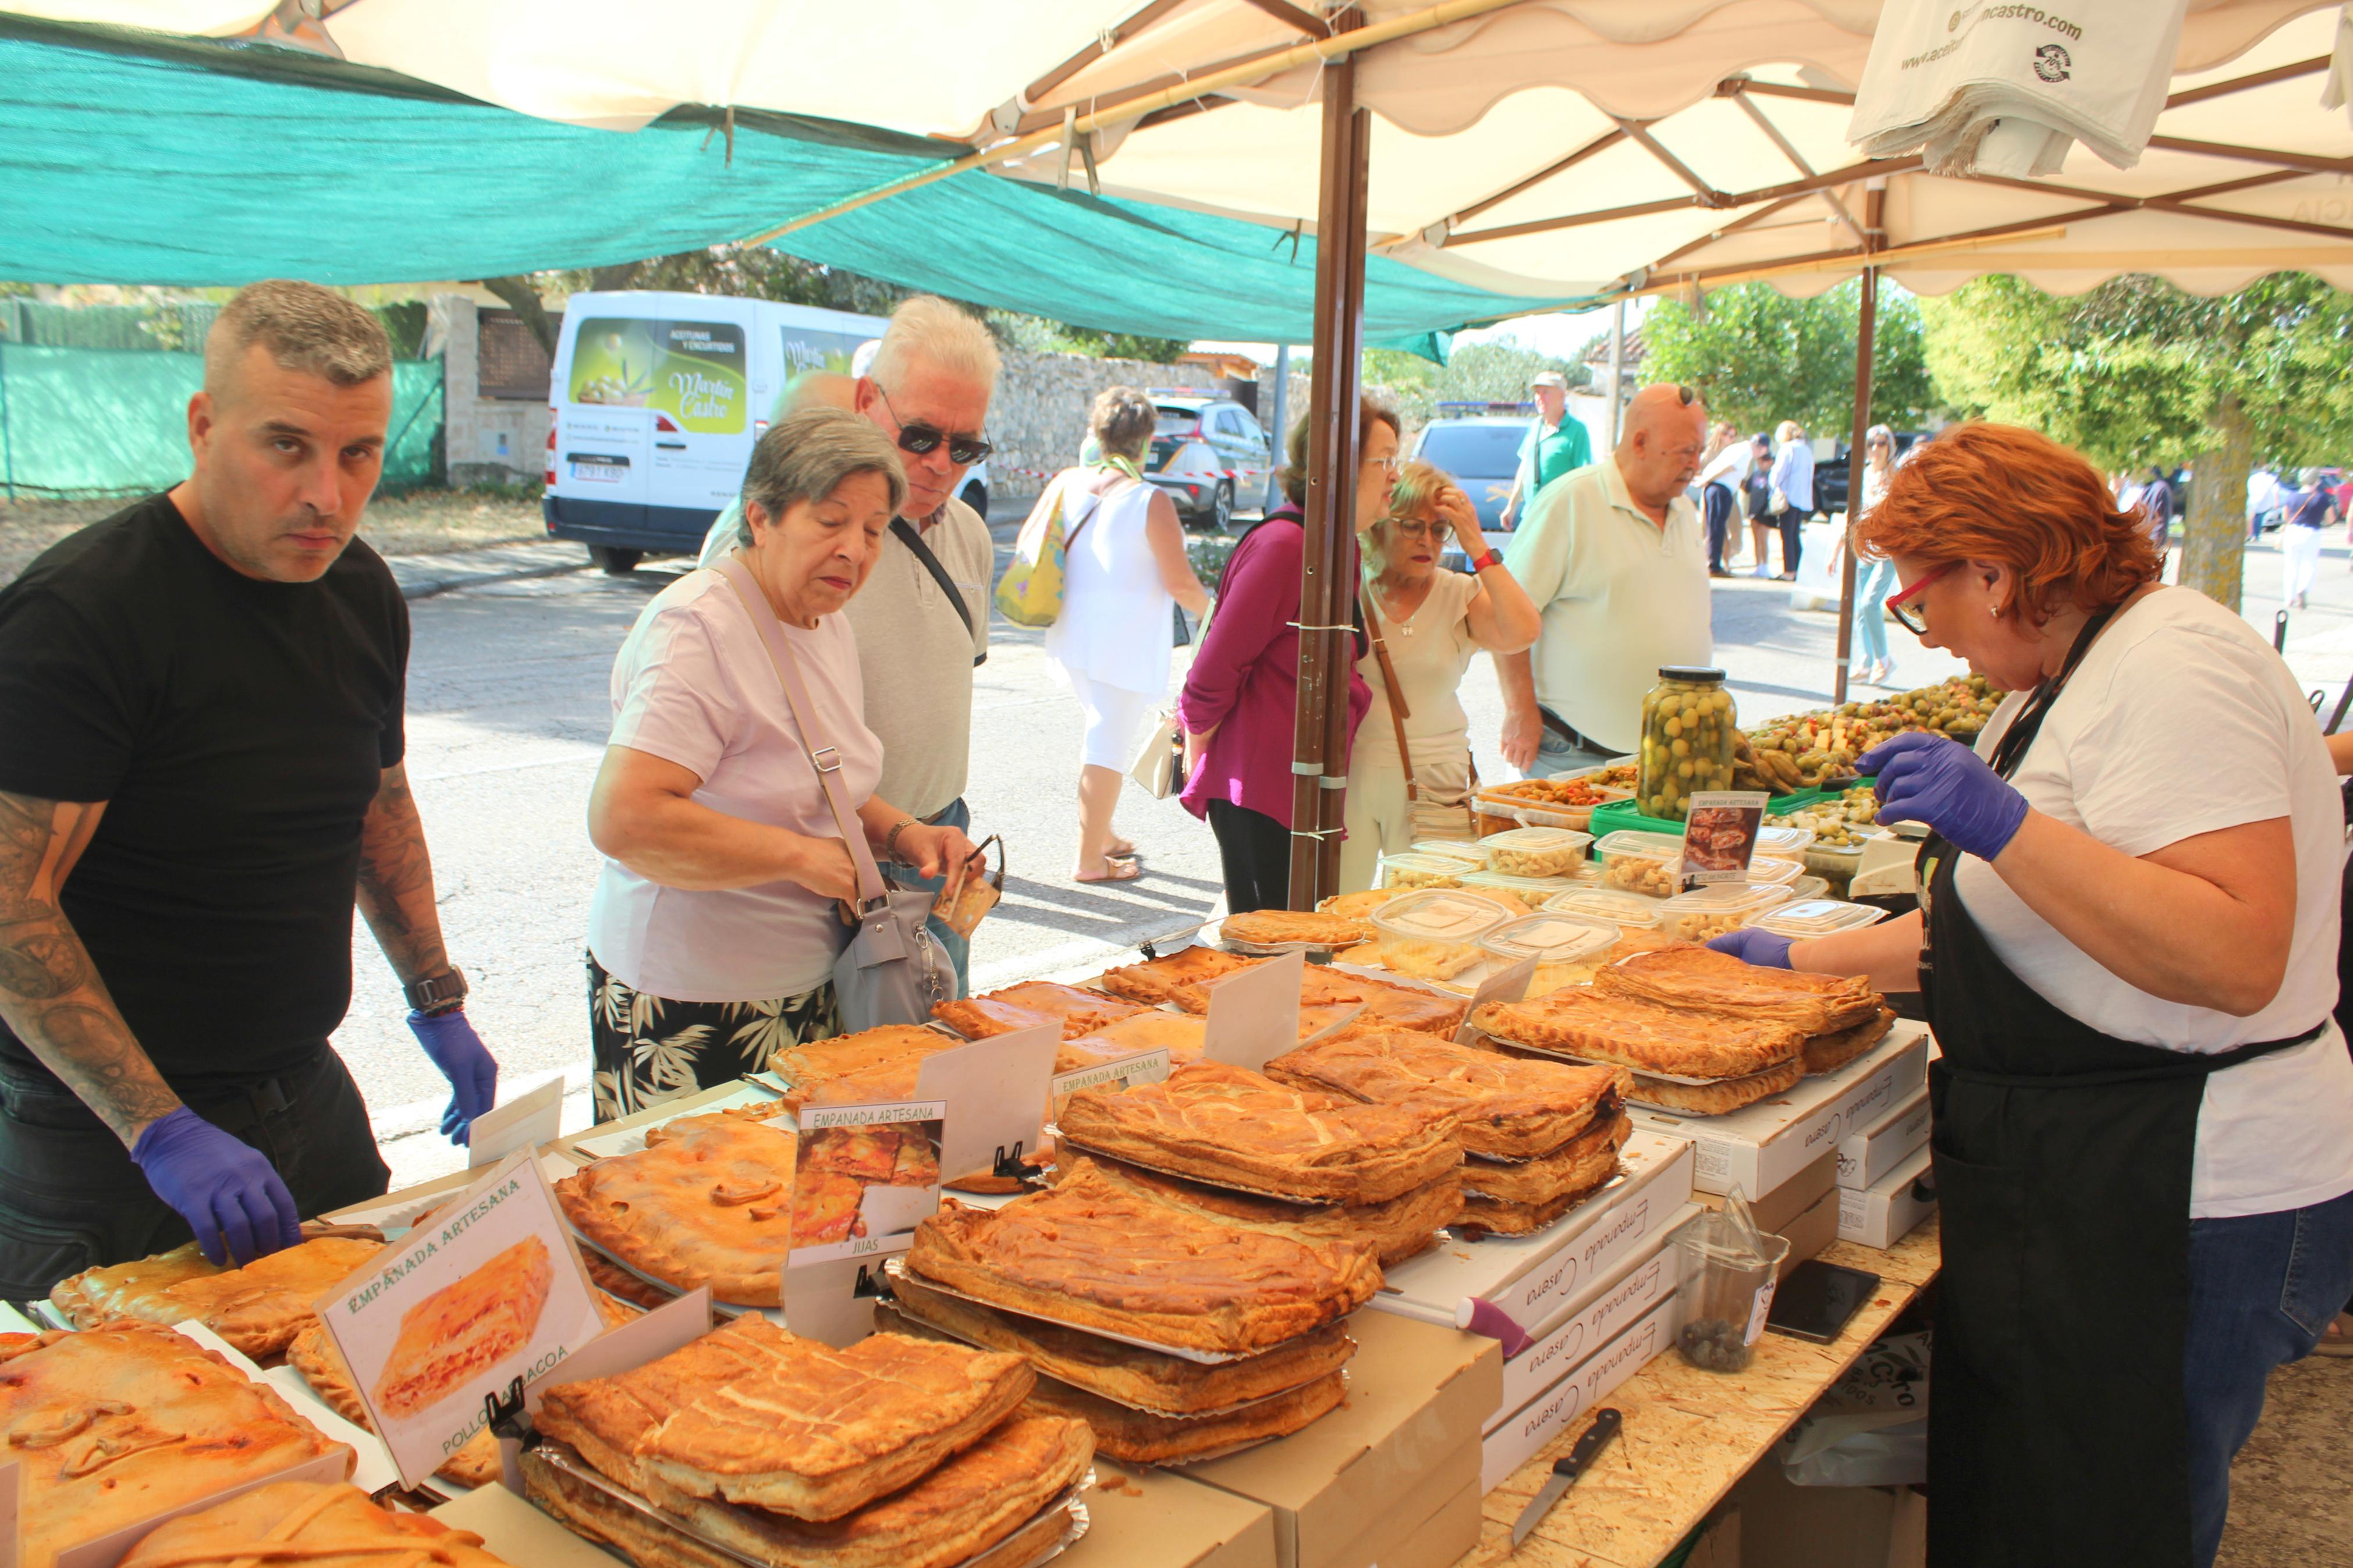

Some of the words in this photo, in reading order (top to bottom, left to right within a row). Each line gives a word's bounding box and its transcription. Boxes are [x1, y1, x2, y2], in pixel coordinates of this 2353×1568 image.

[670, 329, 711, 341] ACEITUNAS
[689, 340, 735, 353] ENCURTIDOS
[680, 391, 727, 419] Castro
[1063, 1071, 1111, 1092] EMPANADA
[1113, 1058, 1159, 1078] ARTESANA
[814, 1110, 874, 1128] EMPANADA
[879, 1107, 934, 1122] ARTESANA
[347, 1242, 439, 1315] EMPANADA
[441, 1179, 521, 1246] ARTESANA
[853, 1239, 879, 1254] JIJAS
[1585, 1199, 1648, 1275] Empanada
[1527, 1257, 1577, 1306] Casera
[1592, 1261, 1660, 1338] Empanada
[1529, 1322, 1584, 1373] Casera
[1588, 1322, 1656, 1399] Empanada
[442, 1409, 489, 1455] POLLO
[1525, 1385, 1579, 1438] Casera
